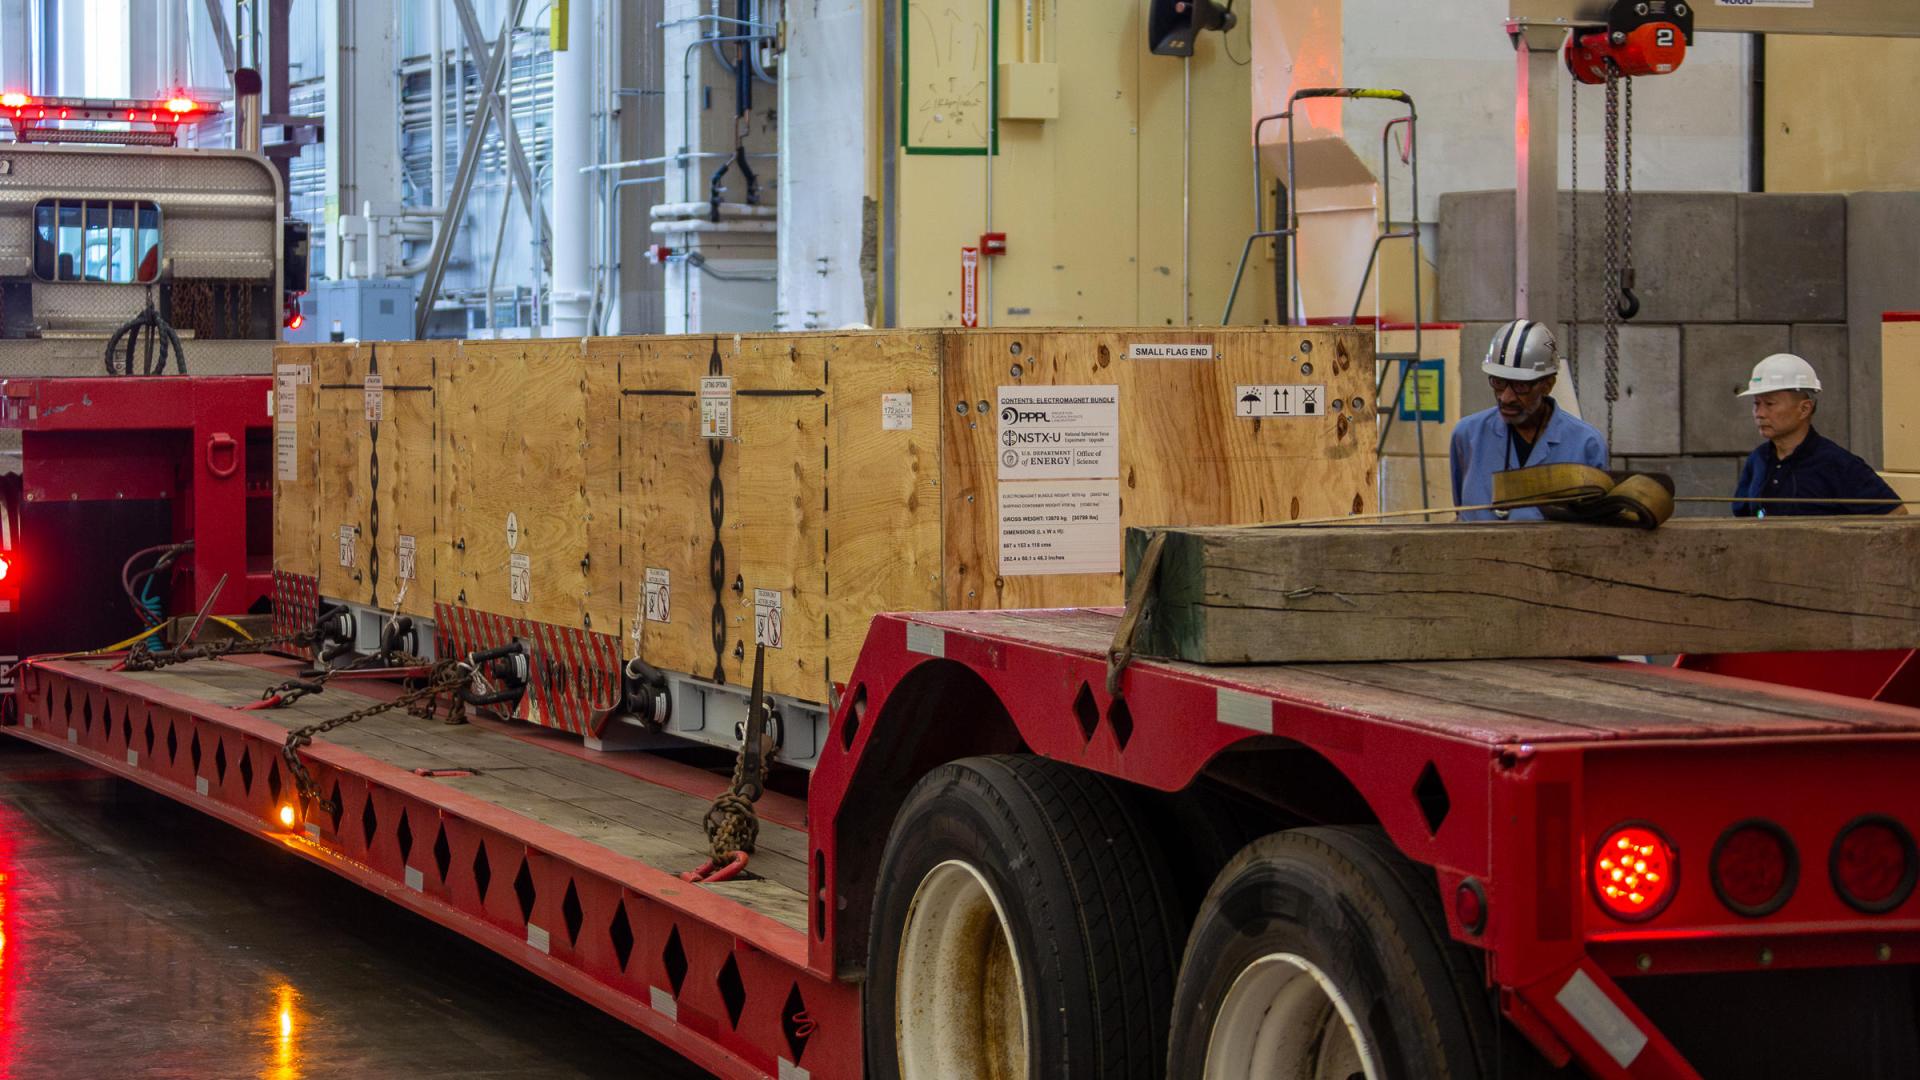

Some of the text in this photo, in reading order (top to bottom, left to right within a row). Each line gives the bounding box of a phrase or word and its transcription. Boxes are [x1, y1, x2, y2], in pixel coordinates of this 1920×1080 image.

[1656, 28, 1673, 46] 2
[1136, 348, 1164, 356] SMALL
[1166, 348, 1188, 356] FLAG
[1020, 412, 1050, 422] PPPL
[1018, 432, 1060, 442] NSTX-U
